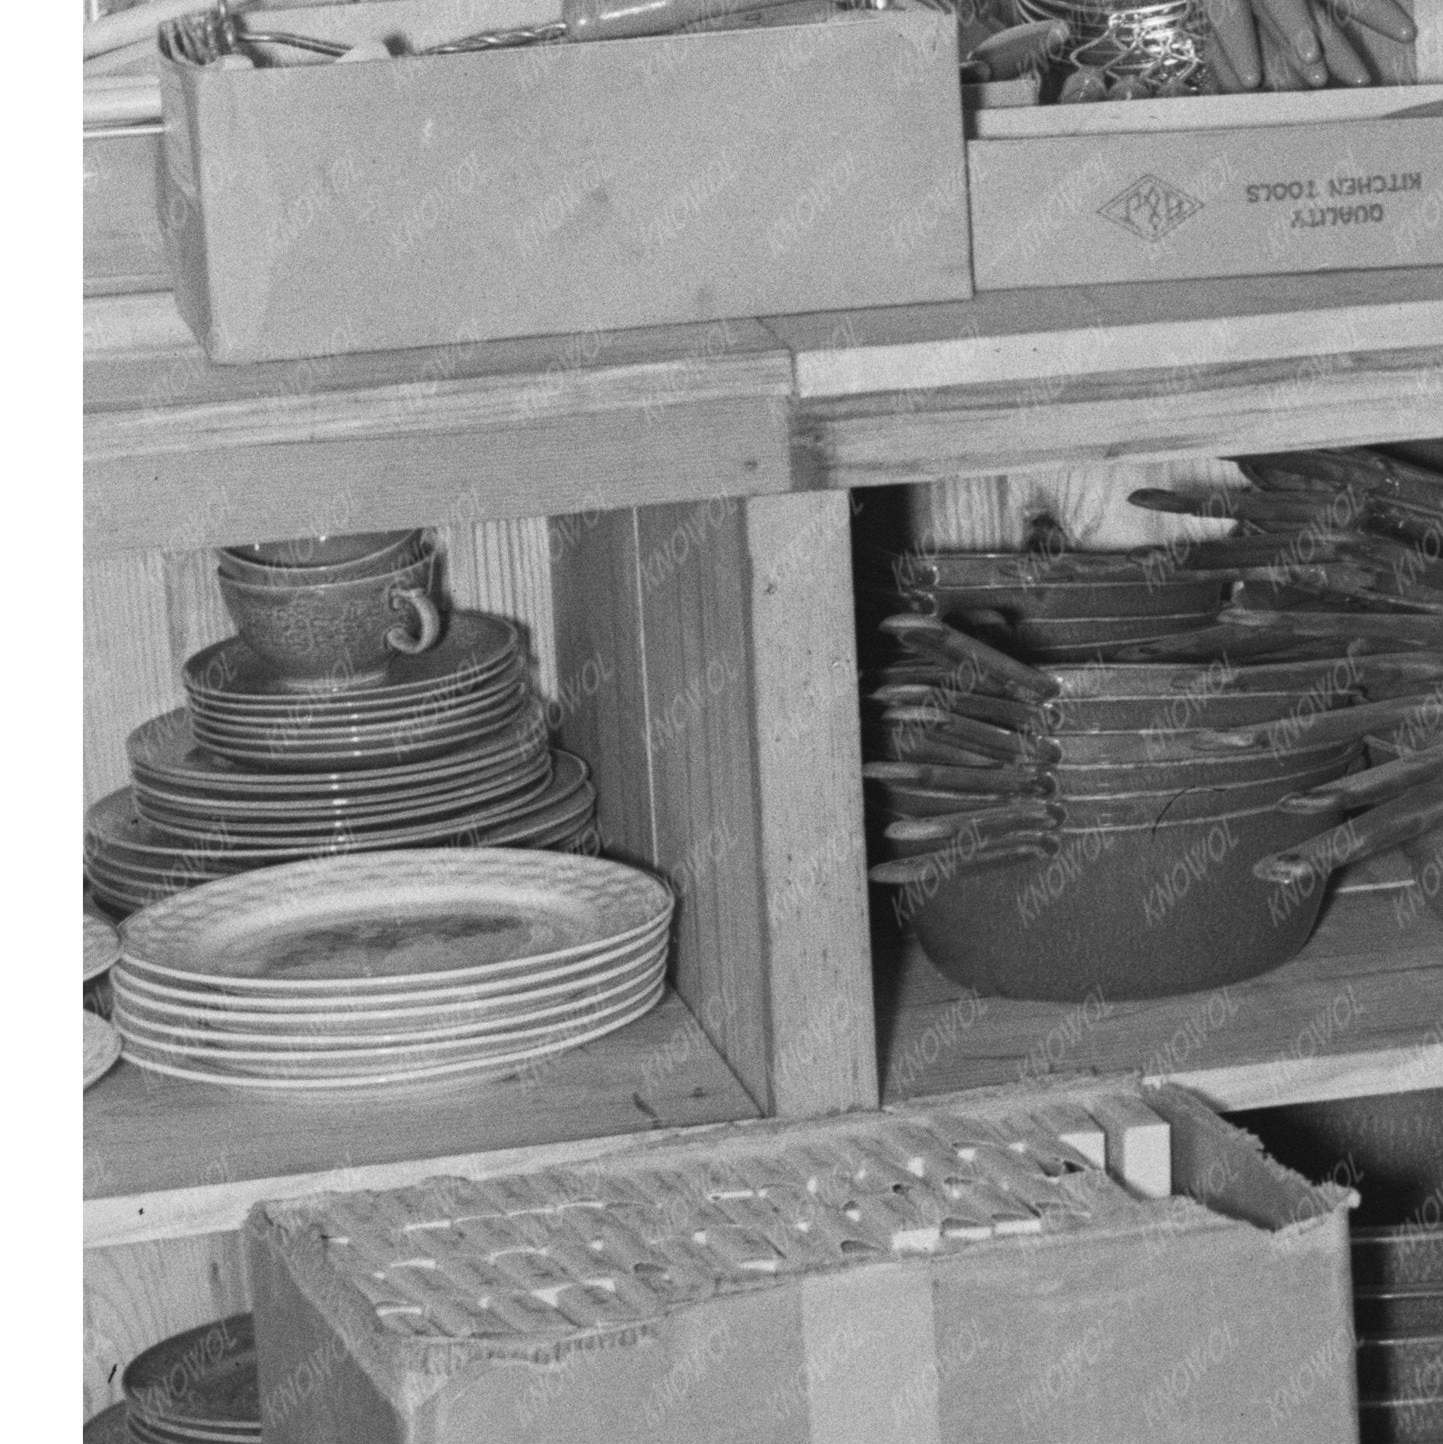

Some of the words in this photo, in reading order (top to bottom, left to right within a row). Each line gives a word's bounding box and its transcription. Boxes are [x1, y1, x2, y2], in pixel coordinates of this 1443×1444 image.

[1246, 182, 1316, 204] TOOLS
[1328, 171, 1423, 199] KITCHEN
[1289, 202, 1385, 229] QUALITY
